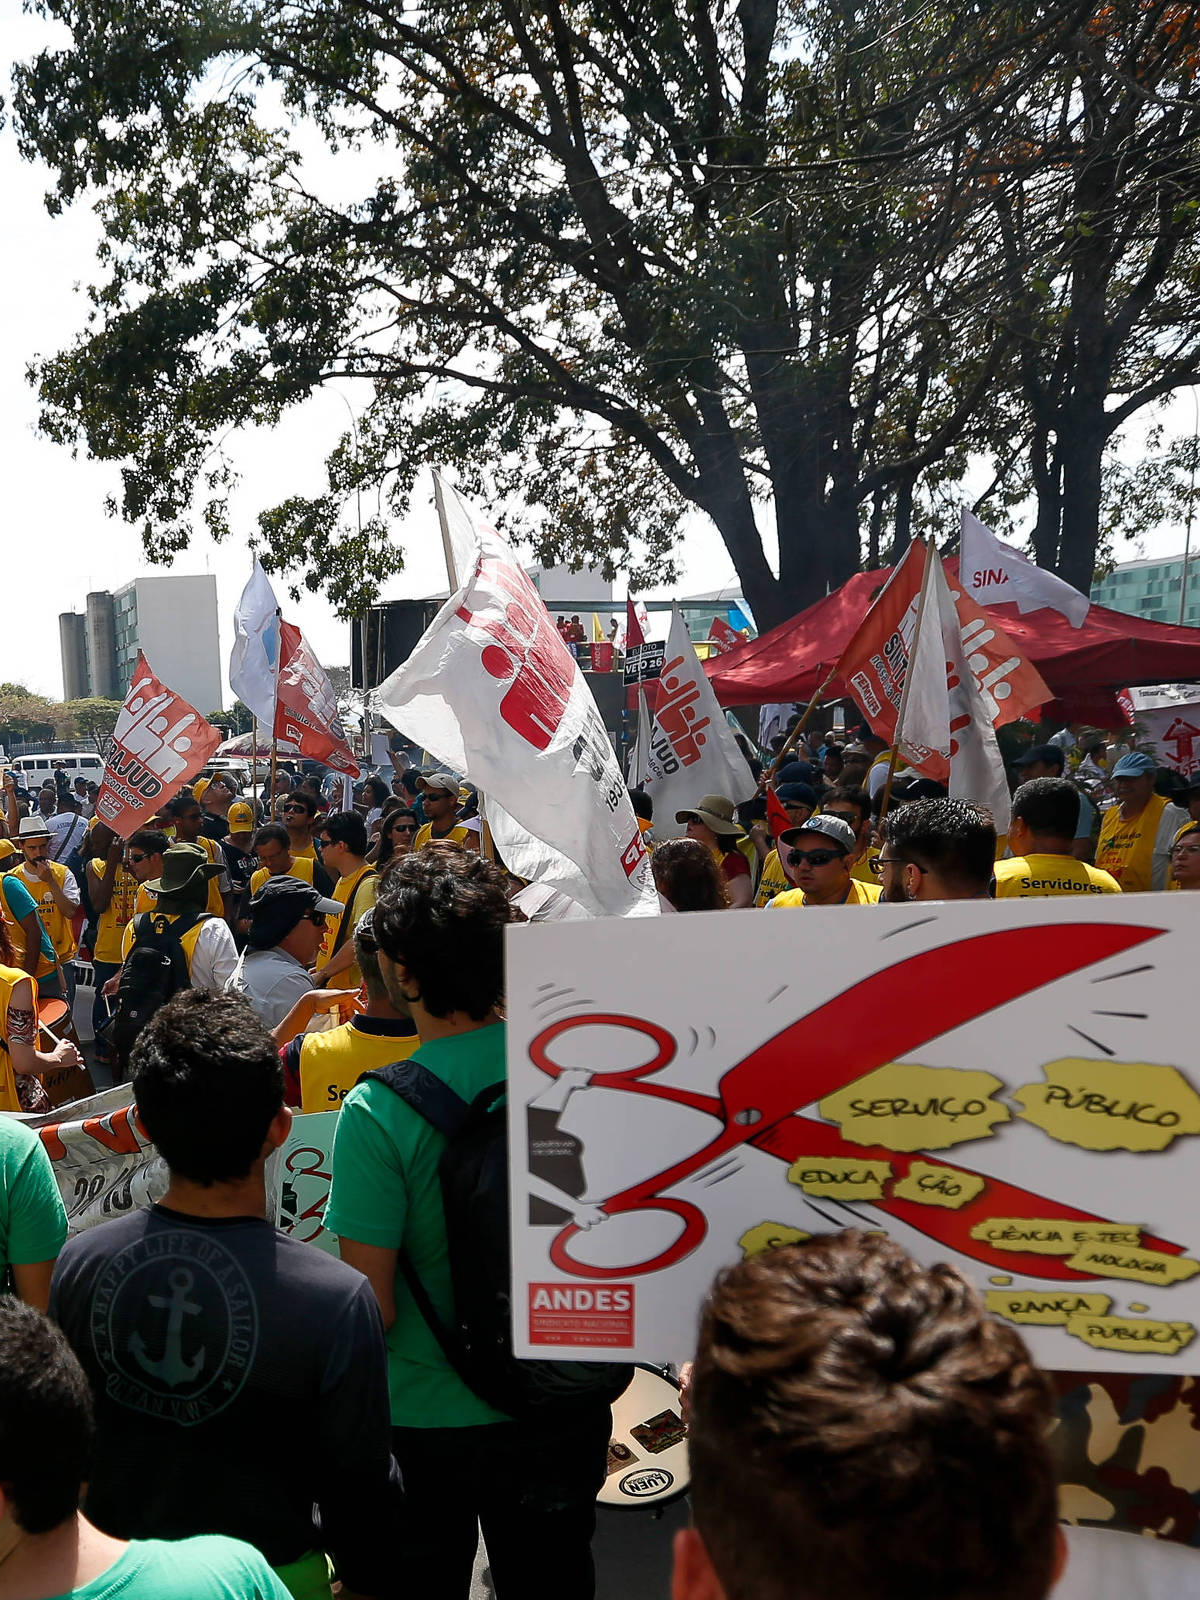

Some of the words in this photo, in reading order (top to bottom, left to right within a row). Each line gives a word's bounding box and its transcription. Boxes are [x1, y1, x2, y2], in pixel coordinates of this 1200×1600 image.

[649, 657, 663, 669] 26
[1020, 876, 1104, 894] Servidores
[849, 1096, 987, 1122] SERVIÇO
[1043, 1084, 1181, 1128] PÚBLICO
[801, 1169, 881, 1186] EDUCA
[916, 1174, 963, 1198] ÇÃO
[987, 1226, 1064, 1242] CIÊNCIA
[94, 1246, 138, 1315] HAPPY
[143, 1234, 194, 1257] LIFE
[197, 1240, 224, 1267] OF
[215, 1266, 236, 1282] A
[227, 1282, 252, 1370] SAILOR
[533, 1288, 632, 1312] ANDES
[627, 1476, 668, 1494] LUEN
